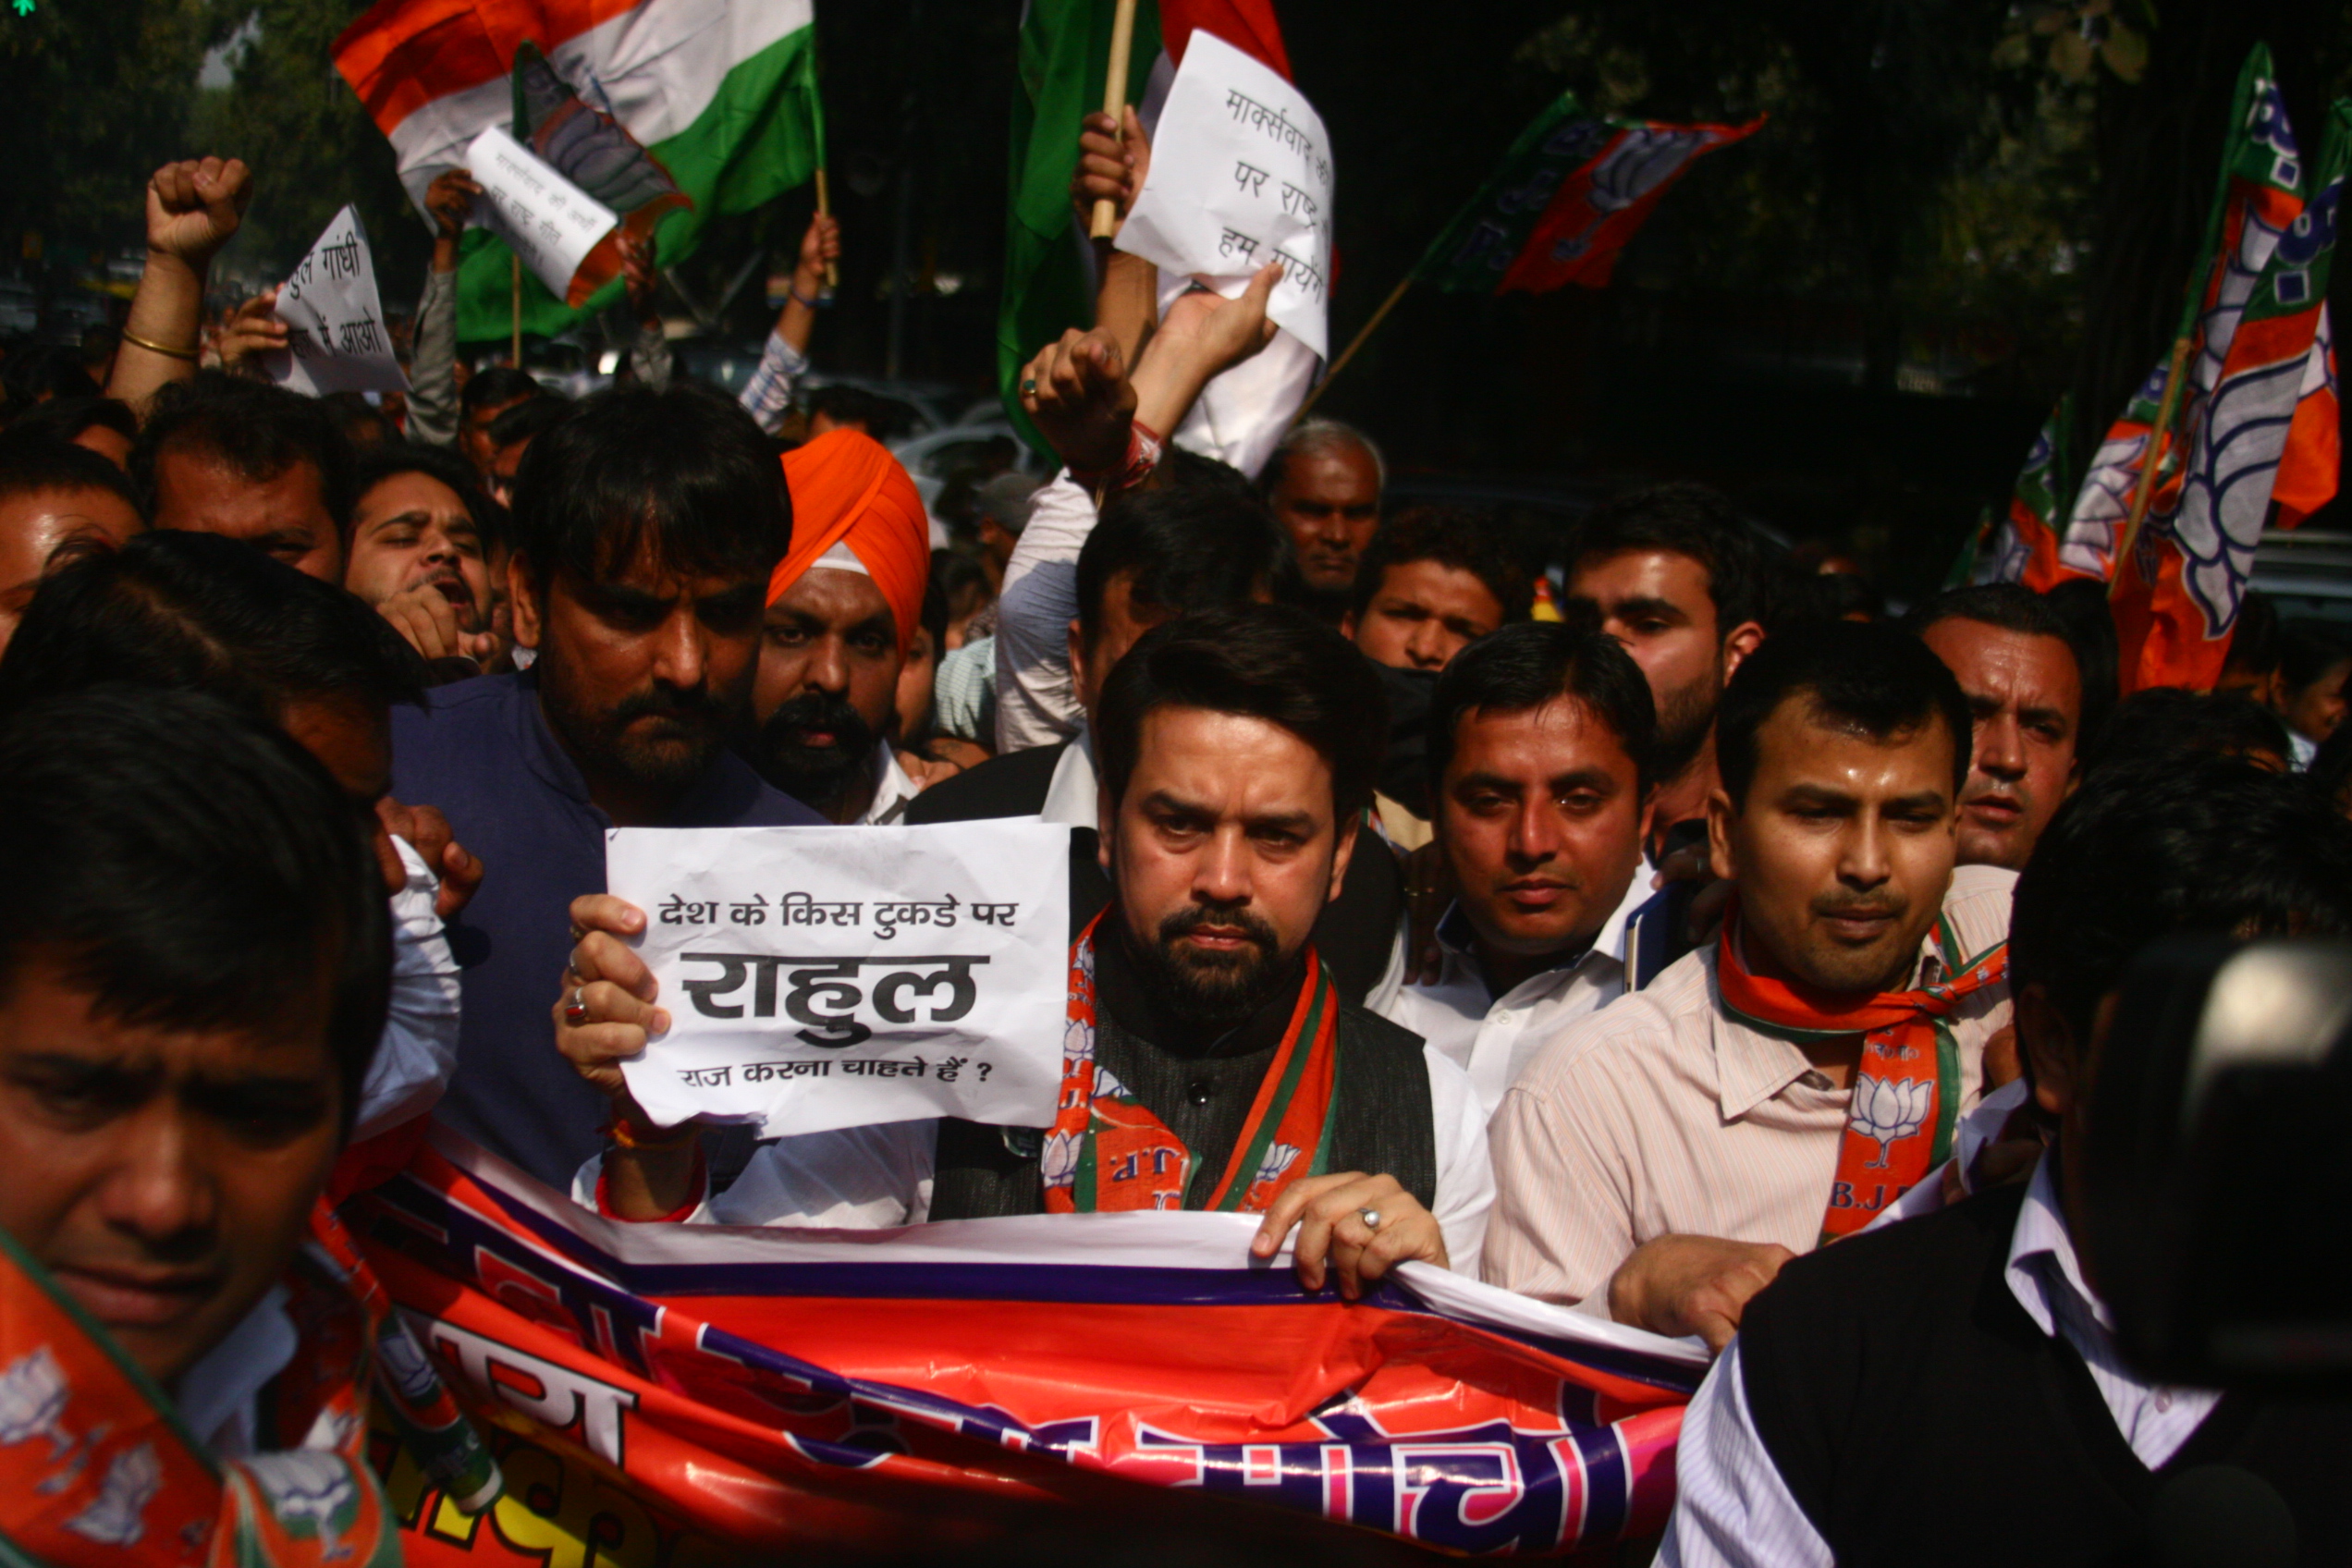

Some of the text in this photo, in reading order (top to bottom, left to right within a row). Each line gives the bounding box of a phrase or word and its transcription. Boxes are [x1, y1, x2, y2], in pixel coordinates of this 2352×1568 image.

[1226, 89, 1313, 161] मार्क्सवाद
[1234, 161, 1270, 198] पर
[322, 229, 361, 281] गांधी
[1219, 227, 1260, 265] हम
[340, 306, 382, 356] आओ
[658, 891, 1019, 940] देश के किस टुकडे पर
[680, 952, 991, 1048] राहुल
[677, 1056, 993, 1087] राज करना चाहते हैं ?
